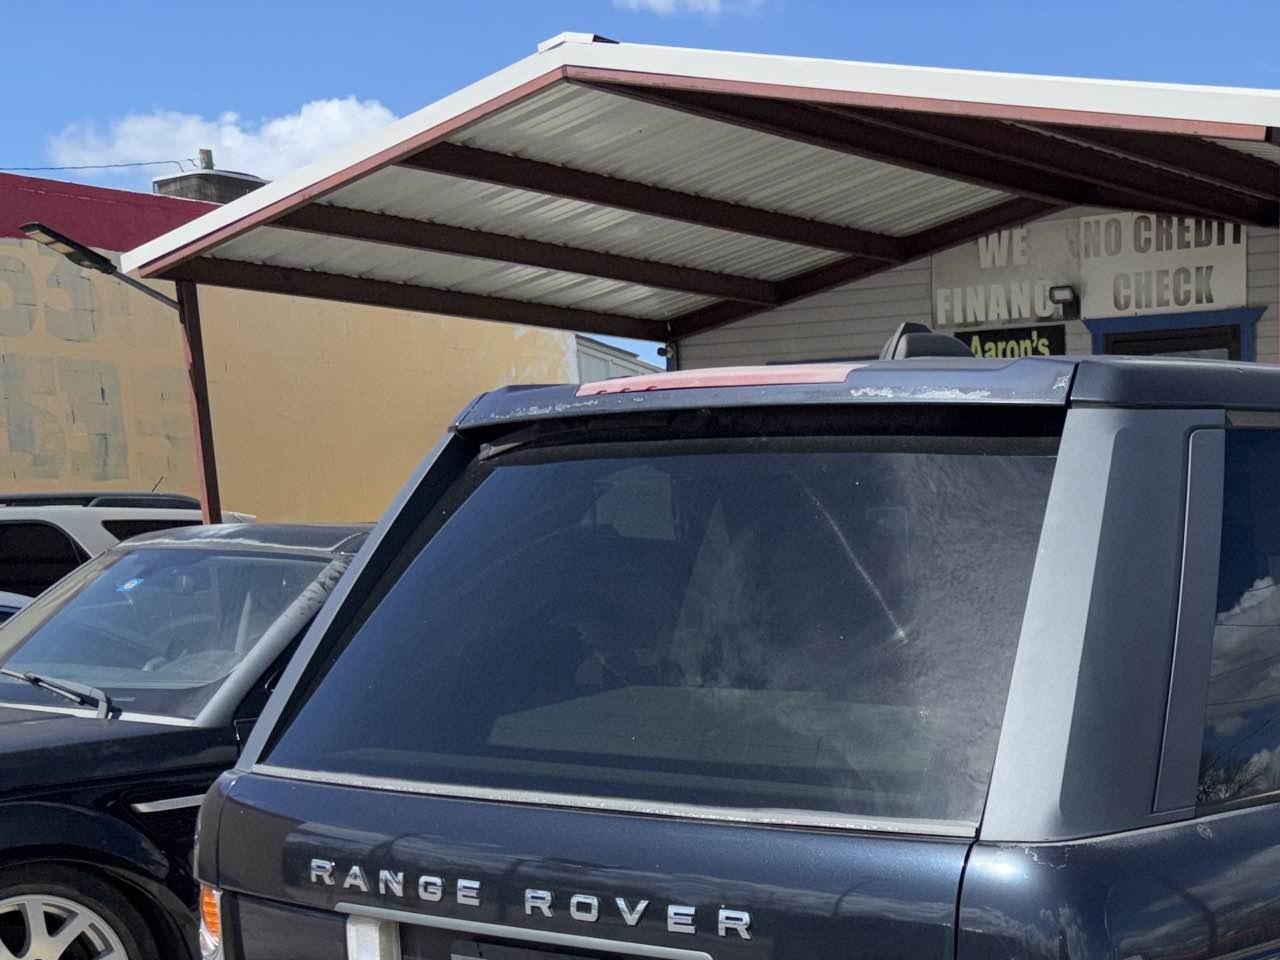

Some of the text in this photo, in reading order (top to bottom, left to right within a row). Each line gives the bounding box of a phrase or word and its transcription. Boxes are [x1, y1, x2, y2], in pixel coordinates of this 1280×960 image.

[978, 228, 1028, 269] WE
[1083, 217, 1122, 258] NO
[936, 278, 1062, 325] FINANC
[1113, 265, 1214, 311] CHECK
[971, 331, 1050, 358] Aaron's
[310, 858, 752, 940] RANGE ROVER
